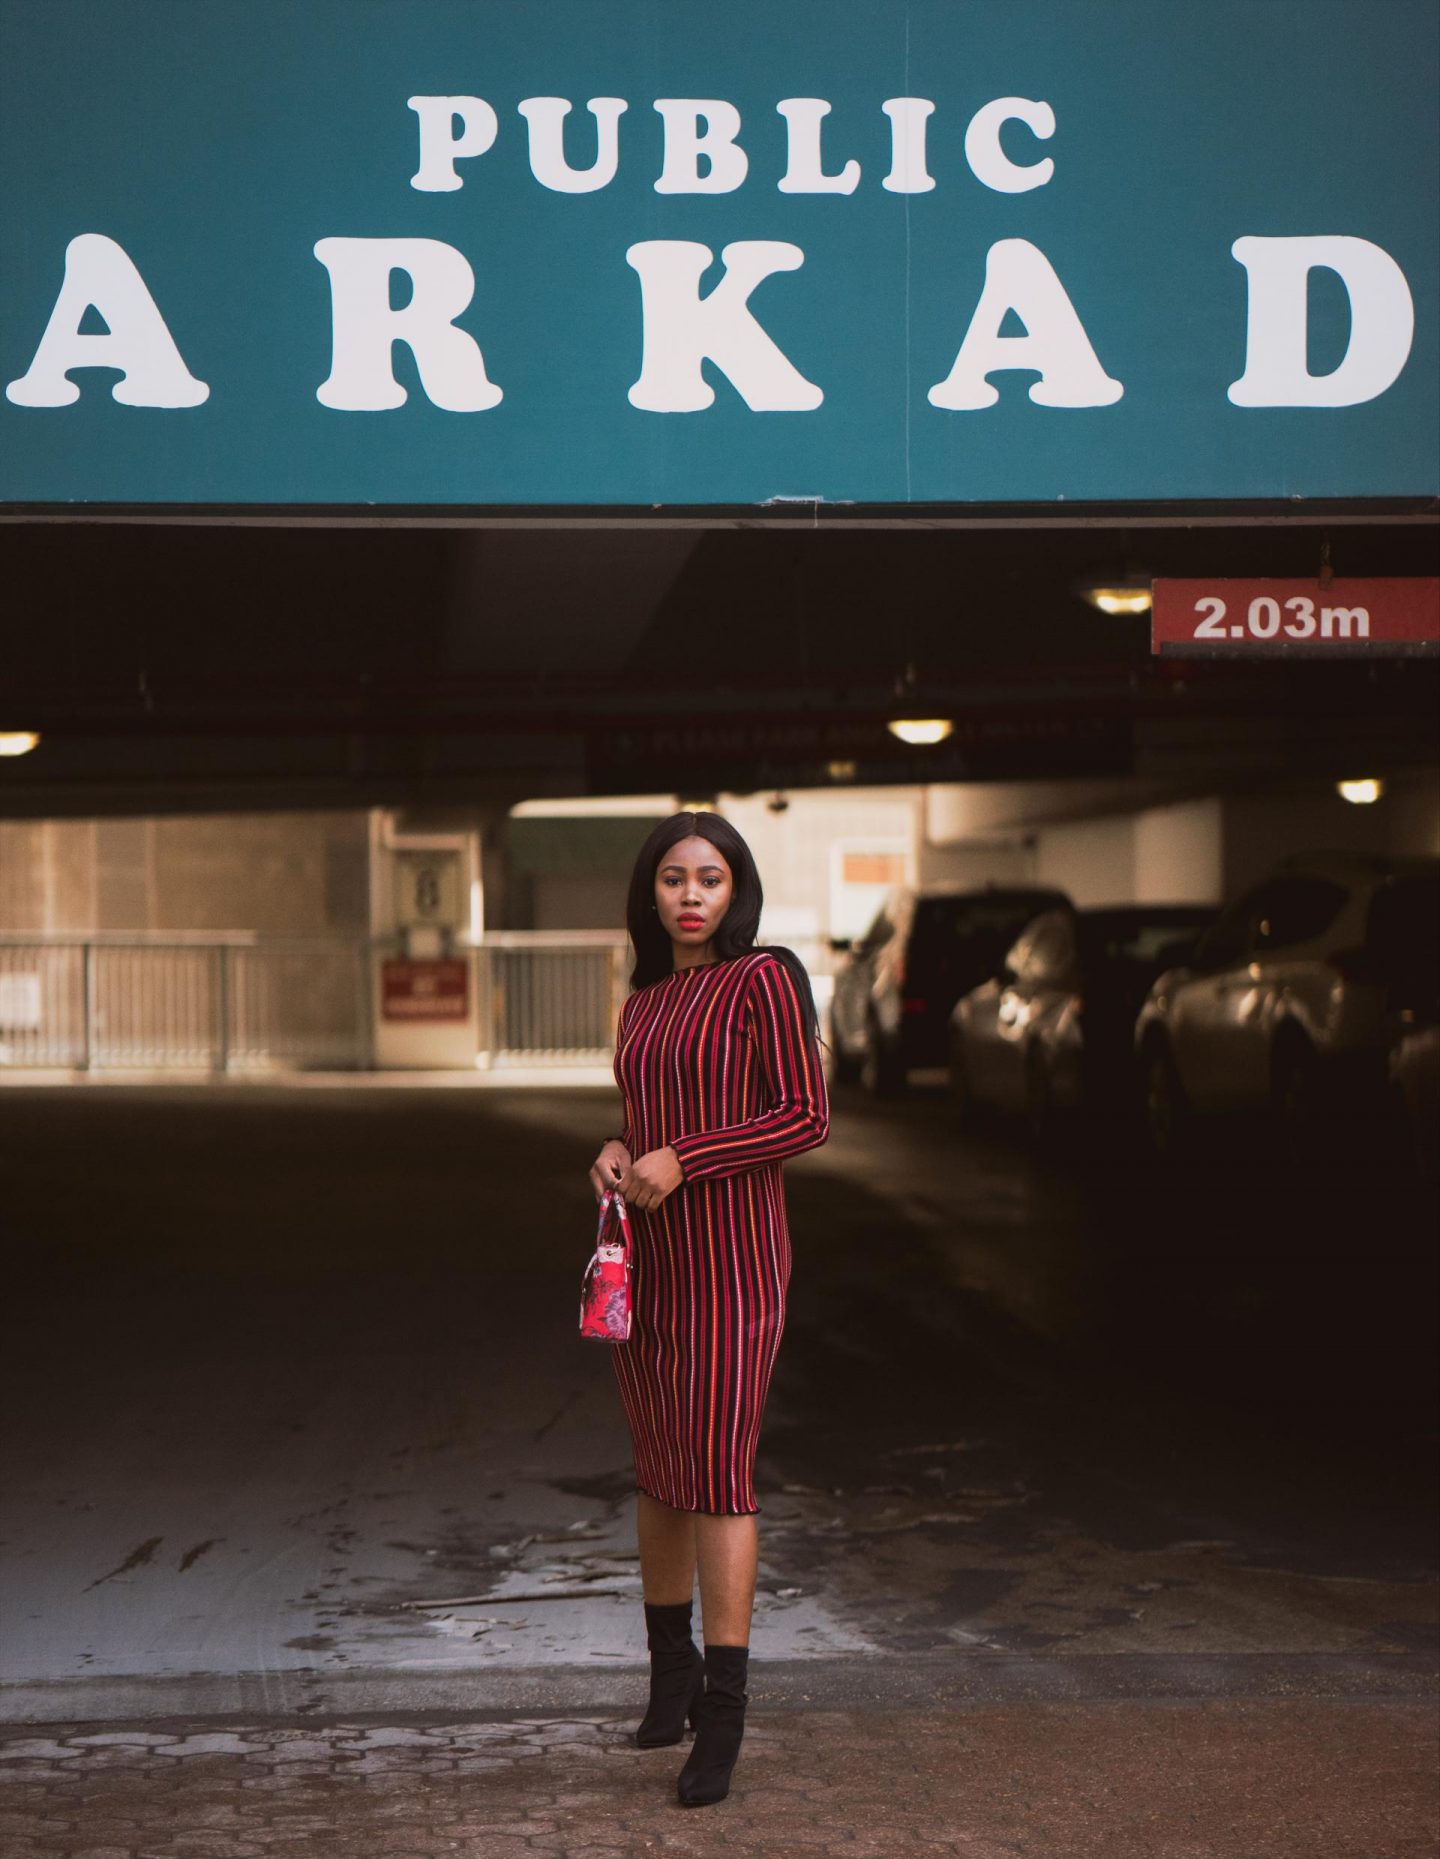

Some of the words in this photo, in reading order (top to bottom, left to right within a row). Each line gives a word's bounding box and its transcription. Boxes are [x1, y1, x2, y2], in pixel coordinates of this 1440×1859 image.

[407, 95, 1056, 196] PUBLIC
[5, 233, 1416, 413] ARKAD
[1193, 596, 1371, 639] 2.03m
